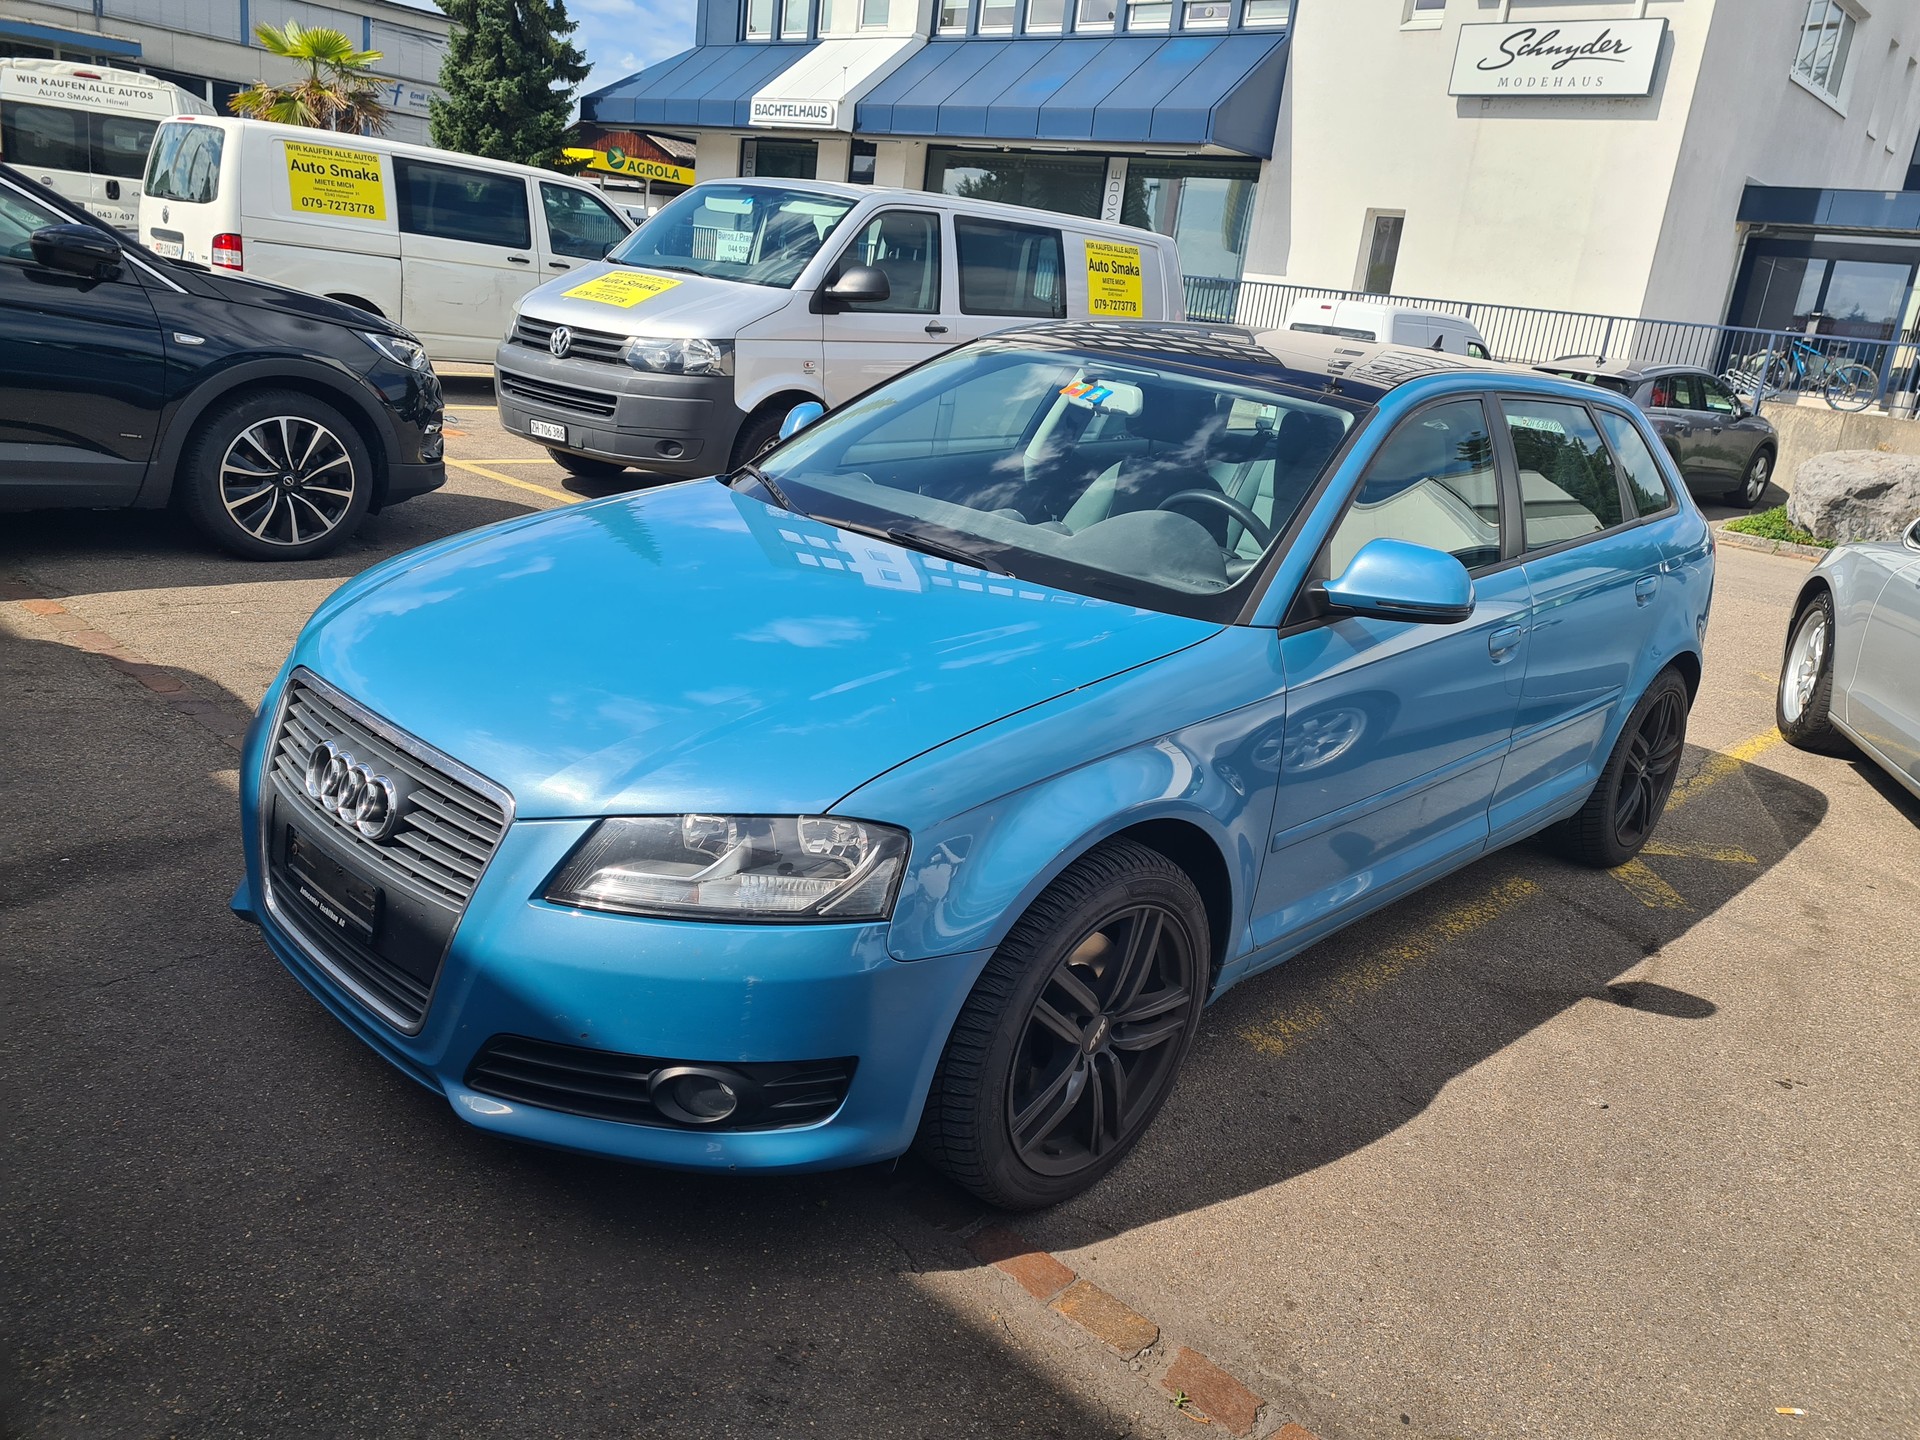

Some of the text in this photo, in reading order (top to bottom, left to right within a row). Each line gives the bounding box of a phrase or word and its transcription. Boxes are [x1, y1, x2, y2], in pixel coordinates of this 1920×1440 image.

[1477, 28, 1632, 71] Schnyder
[16, 74, 154, 100] WIR KAUFEN ALLE AUTOS
[1497, 76, 1604, 88] MODEHAUS
[37, 88, 129, 107] AUTO SMAKA Hinwil
[754, 103, 828, 119] BACHTELHAUS
[286, 143, 301, 151] WIR
[303, 145, 333, 156] KAUFEN
[334, 150, 353, 159] ALLE
[354, 152, 378, 163] AUTOS
[290, 159, 326, 175] Auto
[330, 164, 380, 182] Smaka
[627, 160, 680, 181] AGROLA
[314, 178, 355, 189] MIETE MICH
[1105, 170, 1122, 221] MODE
[301, 196, 376, 215] 079-7273778
[96, 210, 113, 219] 043
[119, 212, 135, 221] 497
[1089, 257, 1140, 276] Auto Smaka
[1094, 298, 1137, 312] 079-7273778
